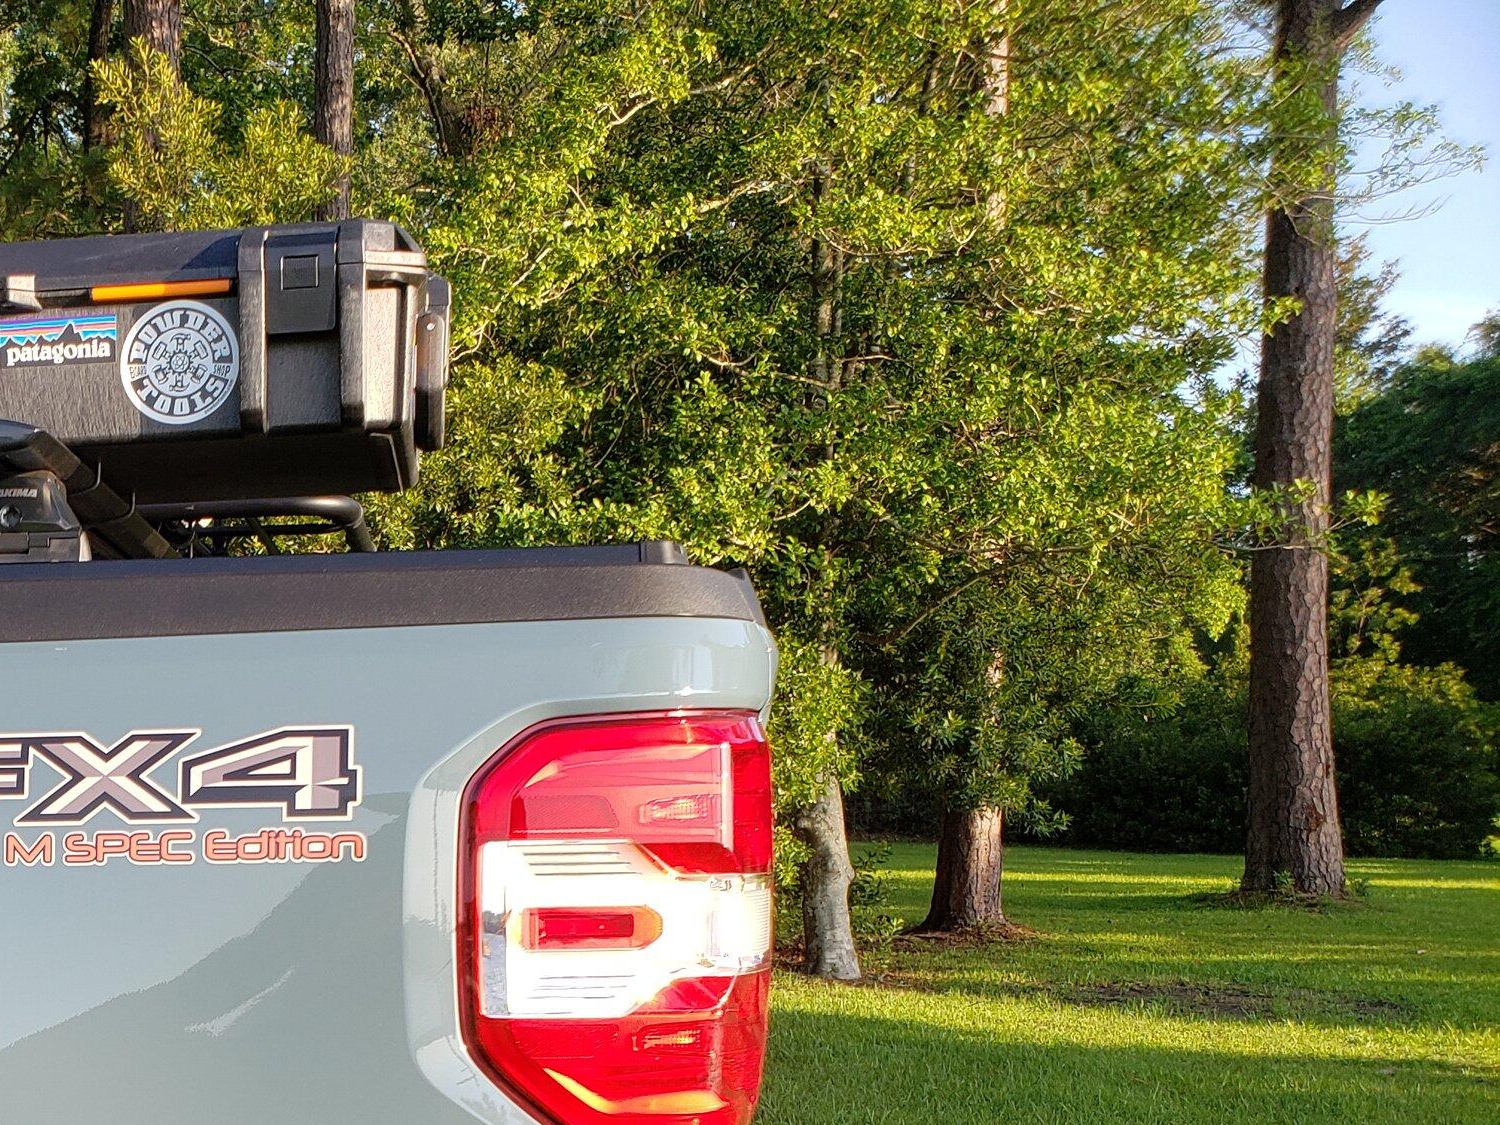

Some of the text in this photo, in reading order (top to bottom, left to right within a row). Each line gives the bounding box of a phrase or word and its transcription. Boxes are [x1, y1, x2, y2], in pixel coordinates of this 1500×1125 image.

[6, 338, 111, 367] patagonia
[129, 309, 232, 363] POWDER
[213, 364, 231, 377] SHOP
[136, 376, 226, 415] TOOLS
[4, 827, 368, 866] M SPEC Edition
